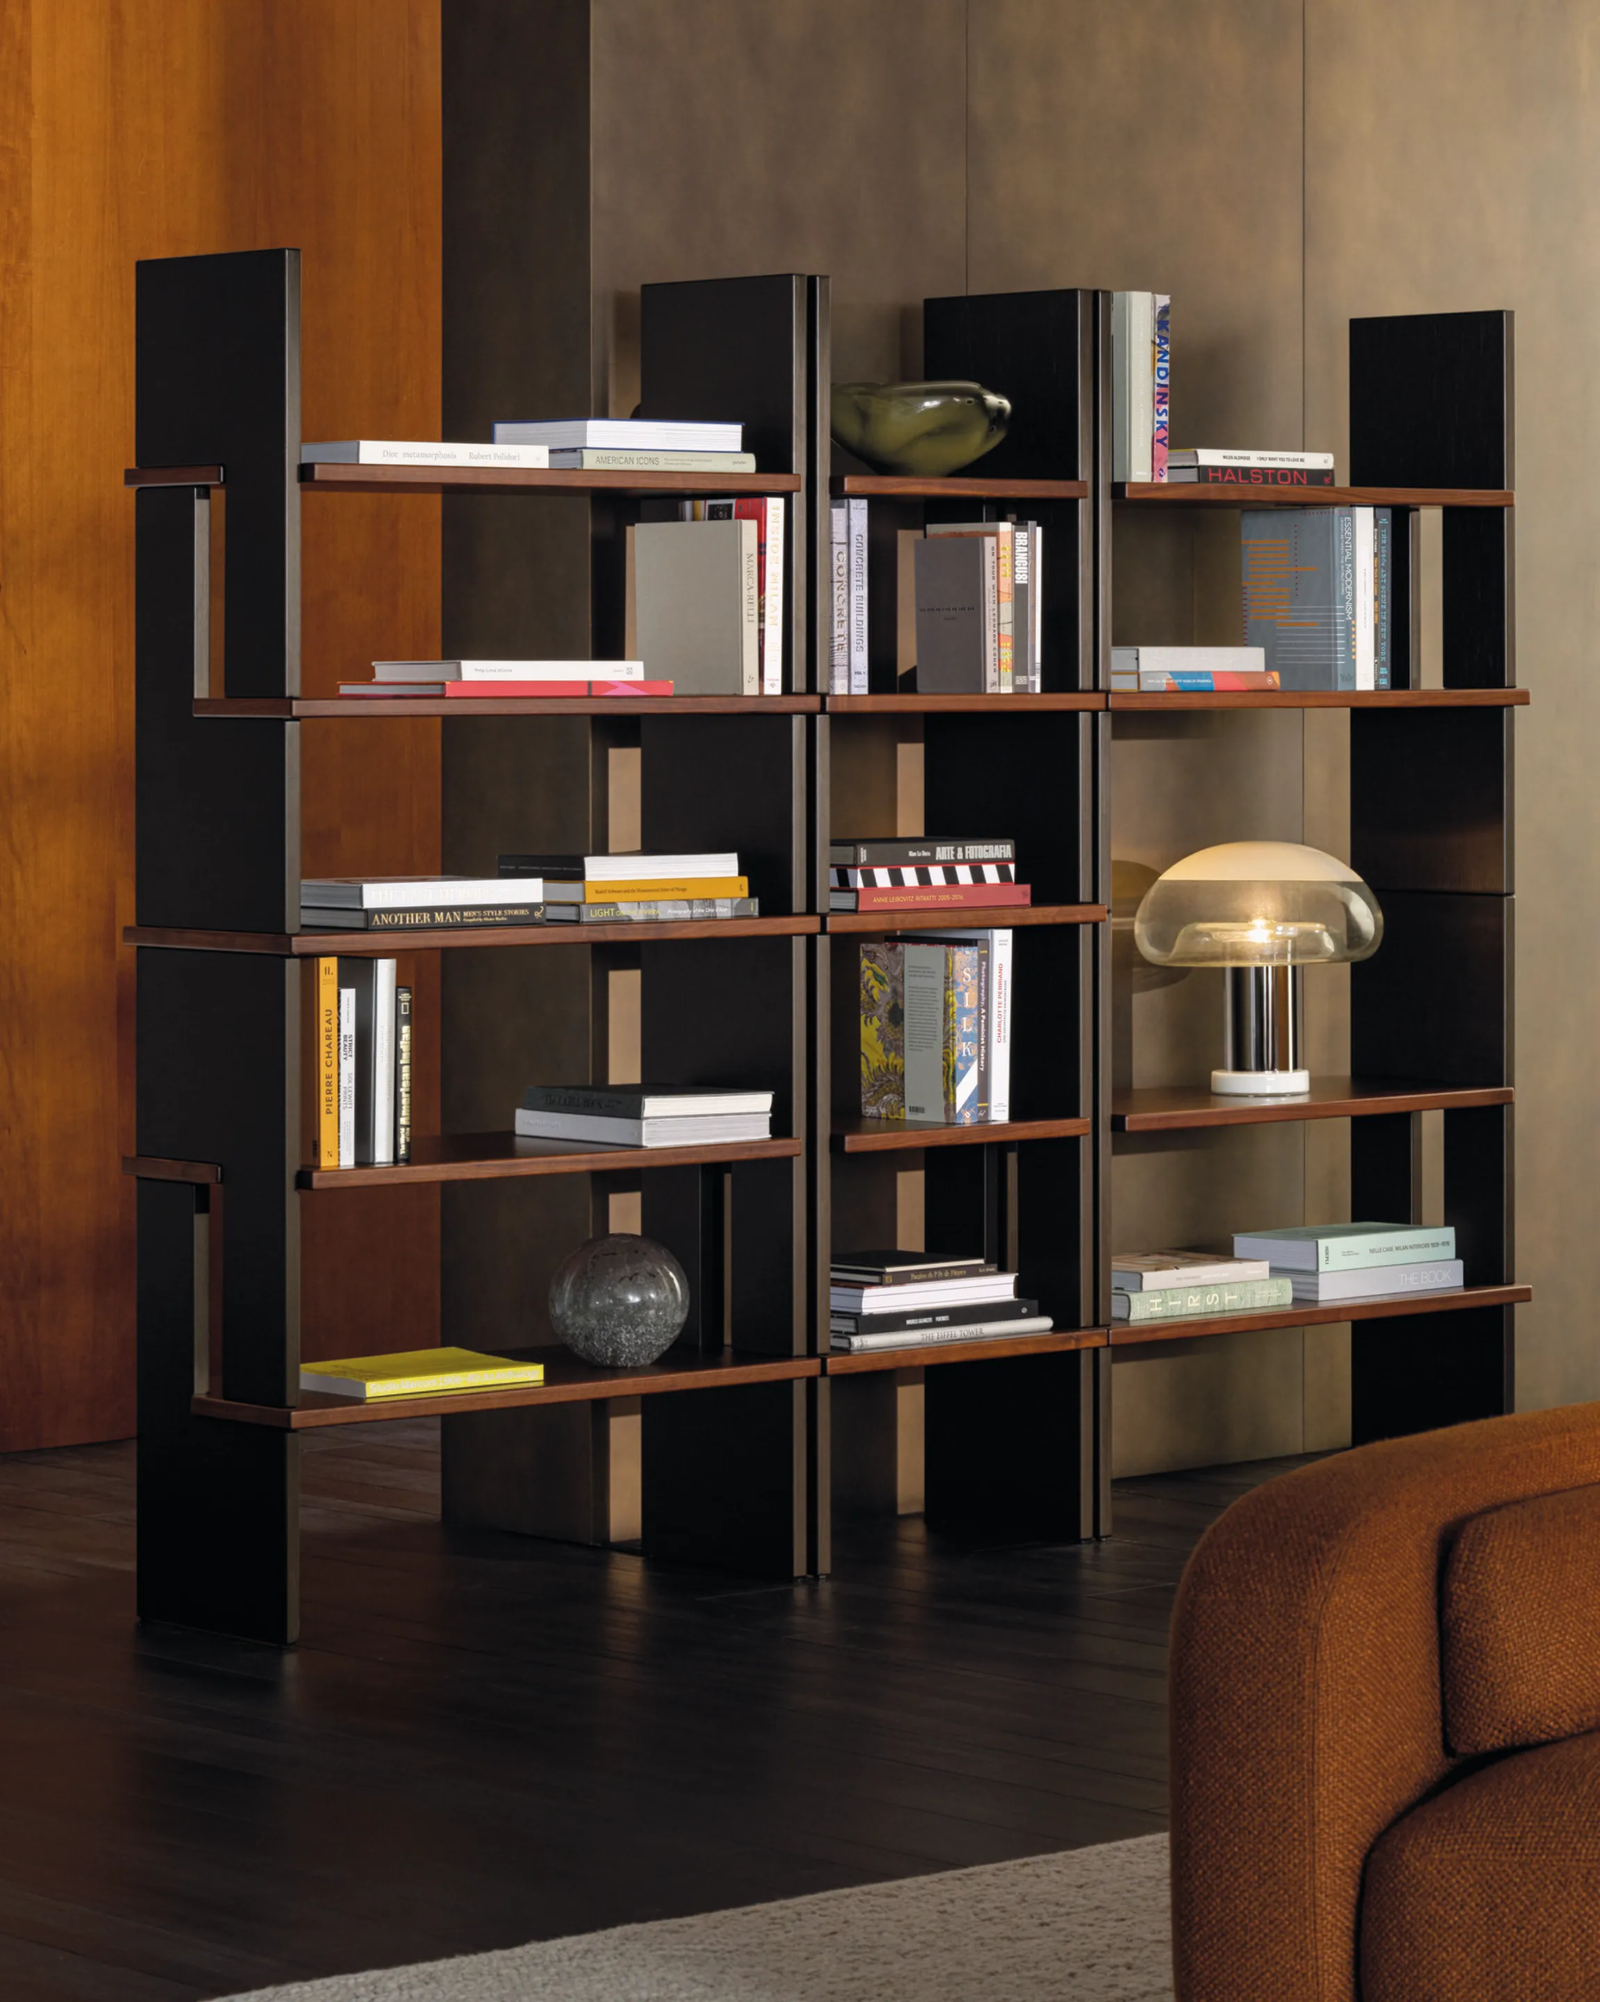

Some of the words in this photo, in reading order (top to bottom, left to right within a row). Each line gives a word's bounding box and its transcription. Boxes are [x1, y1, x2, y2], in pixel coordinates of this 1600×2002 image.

[1155, 319, 1170, 449] KANDINSKY
[382, 450, 398, 458] Dior
[402, 451, 457, 461] metamorphosis
[469, 451, 492, 460] Robert
[493, 451, 520, 461] Polidori
[595, 455, 635, 465] AMERICAN
[636, 456, 660, 466] ICONS
[1208, 468, 1307, 485] HALSTON
[769, 506, 781, 565] INSIDE
[990, 546, 995, 557] ON
[1344, 517, 1353, 561] ESSENTIAL
[855, 534, 864, 592] CONCRETE
[1014, 531, 1028, 584] BRANCUSI
[746, 553, 755, 623] MARCA-RELLI
[768, 571, 780, 627] MILAN
[836, 551, 846, 652] CONCRETE
[1344, 564, 1353, 620] MODERNISM
[855, 595, 864, 652] BUILDINGS
[1381, 611, 1387, 620] IN
[936, 846, 955, 861] ARTE
[957, 847, 963, 860] &
[965, 844, 1012, 860] FOTOGRAFIA
[372, 912, 431, 926] ANOTHER
[434, 910, 461, 923] MAN
[462, 910, 482, 918] MEN'S
[483, 909, 502, 917] STYLE
[503, 908, 529, 916] STORIES
[590, 907, 615, 918] LIGHT
[638, 908, 661, 916] RIVIERA
[324, 966, 333, 975] II.
[979, 961, 987, 1007] Photography,
[962, 967, 972, 1057] SILK
[325, 1008, 333, 1068] CHAREAU
[400, 1025, 410, 1064] Indian
[325, 1071, 333, 1115] PIERRE
[400, 1064, 410, 1125] American
[1409, 1243, 1430, 1251] INTERIORS
[1398, 1273, 1418, 1286] THE
[1420, 1269, 1452, 1285] BOOK
[1149, 1292, 1238, 1312] HIRST
[921, 1333, 934, 1341] THE
[936, 1331, 957, 1340] EIFFEL
[959, 1328, 984, 1338] TOWER
[370, 1382, 399, 1394] Studio
[400, 1377, 437, 1392] Marconi
[483, 1373, 494, 1382] An
[495, 1369, 540, 1383] Anthology
